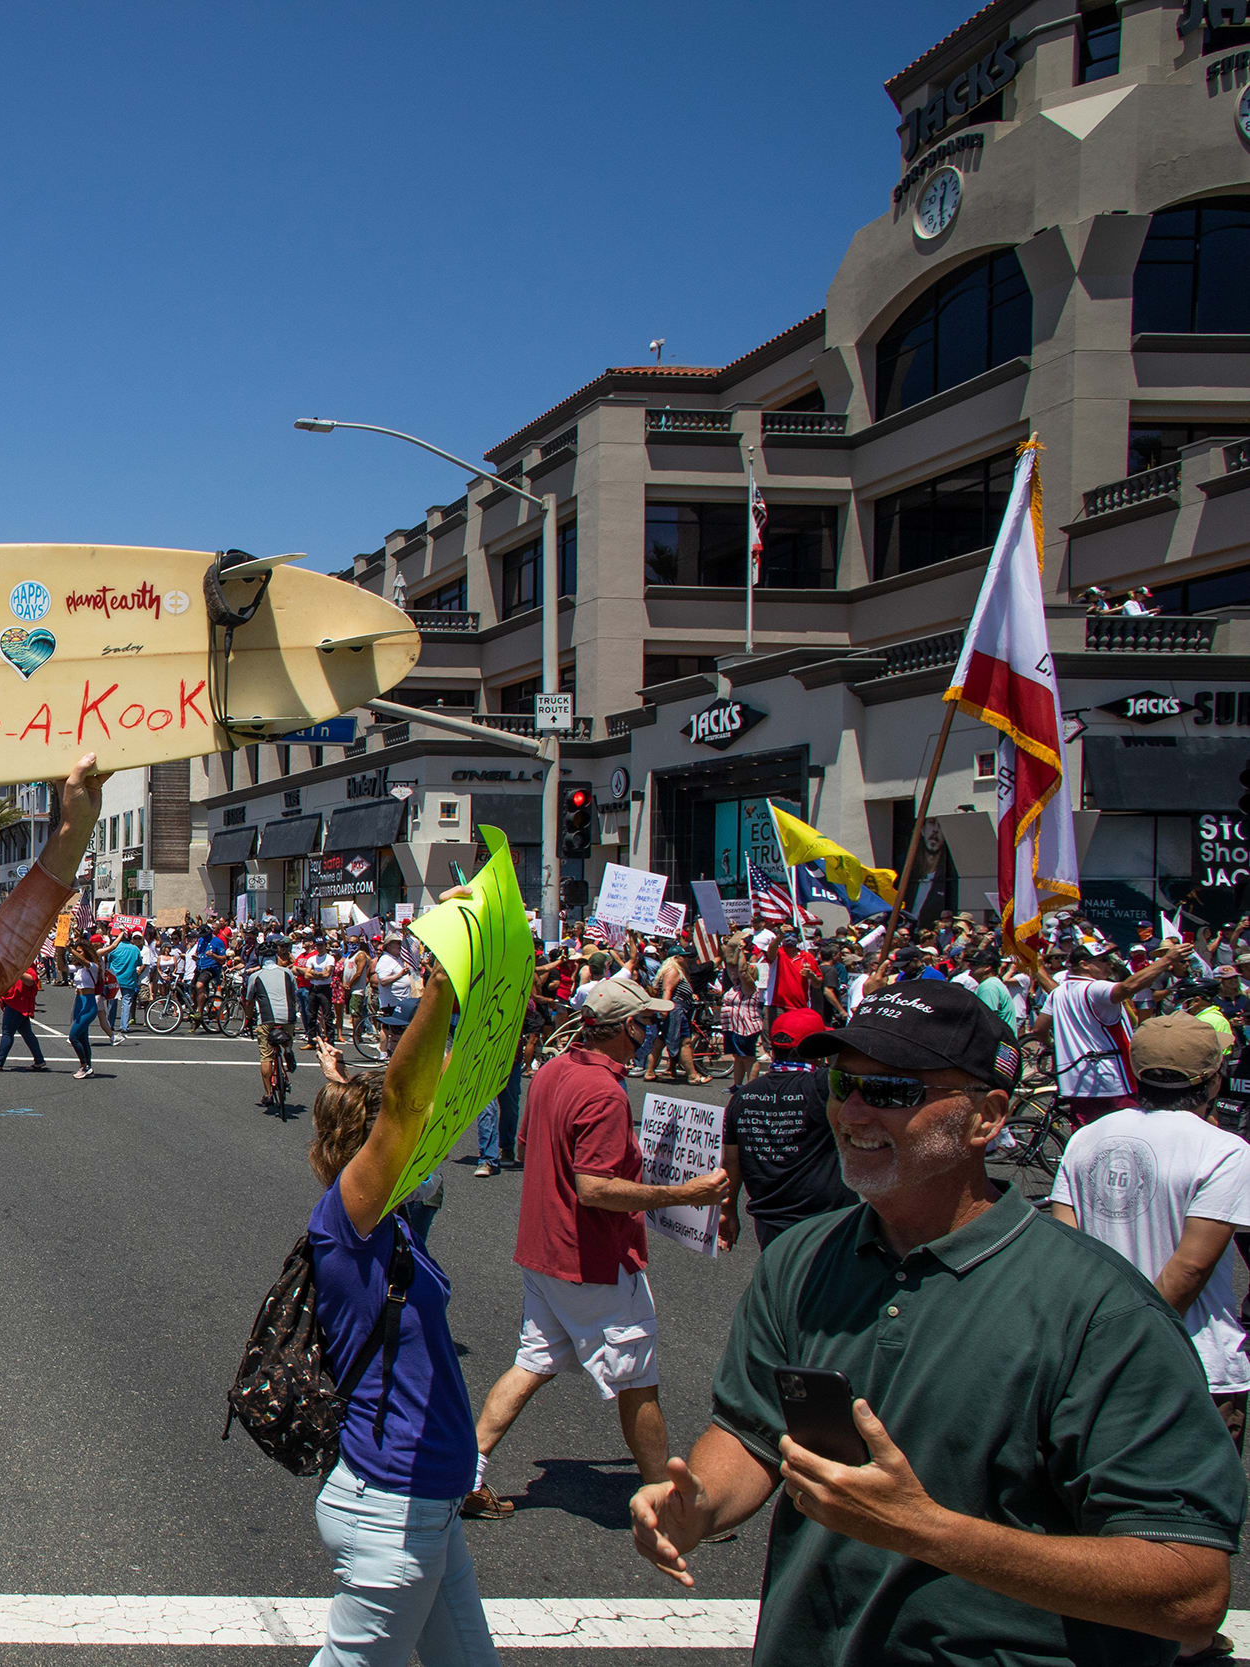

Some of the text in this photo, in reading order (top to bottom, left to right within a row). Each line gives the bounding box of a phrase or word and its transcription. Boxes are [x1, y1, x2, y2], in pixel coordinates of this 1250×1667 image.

[13, 583, 48, 605] HAPPY
[16, 603, 44, 620] DAYS
[538, 697, 569, 705] TRUCK
[538, 706, 569, 714] ROUTE
[1126, 696, 1181, 717] JACK'S
[296, 726, 330, 737] ain
[1200, 842, 1250, 867] Sho
[1084, 899, 1116, 908] NAME
[1113, 909, 1148, 919] WATER
[875, 1007, 903, 1019] 1922
[878, 992, 935, 1014] Arches
[653, 1100, 714, 1128] THE ONLY THING
[643, 1118, 720, 1150] NECESSARY FOR THE
[643, 1137, 716, 1171] TRIUMPH OF EVIL IS
[643, 1158, 657, 1178] FOR
[659, 1161, 680, 1182] GOOD
[659, 1215, 713, 1247] WEHAVERIGHTS.COM
